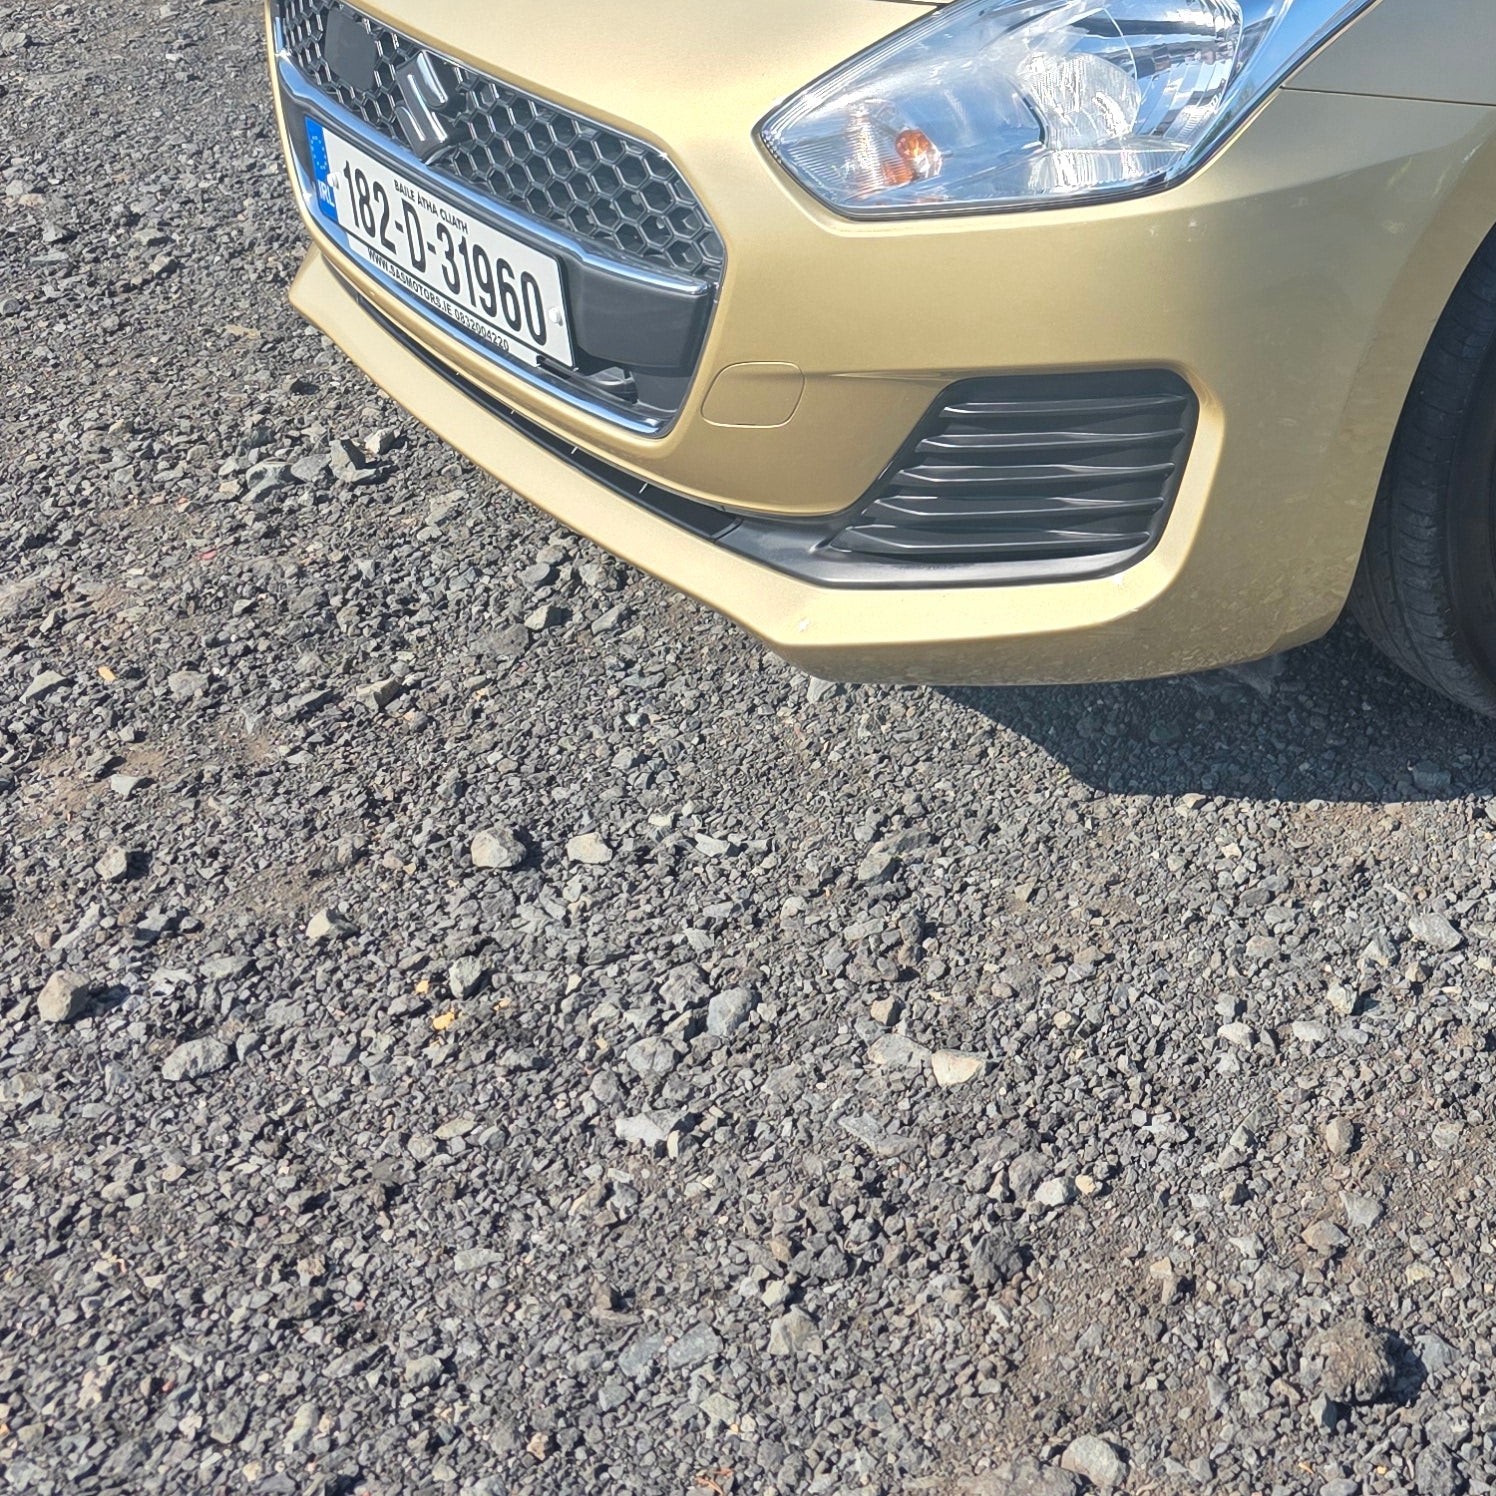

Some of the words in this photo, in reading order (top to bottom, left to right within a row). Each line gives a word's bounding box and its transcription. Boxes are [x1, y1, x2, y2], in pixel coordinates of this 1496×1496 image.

[318, 179, 335, 207] IRL
[394, 179, 414, 201] BAILE
[440, 208, 468, 234] CLIATH
[343, 160, 547, 346] 182-D-31960
[367, 245, 453, 316] WWW.SASMOTORS.IE
